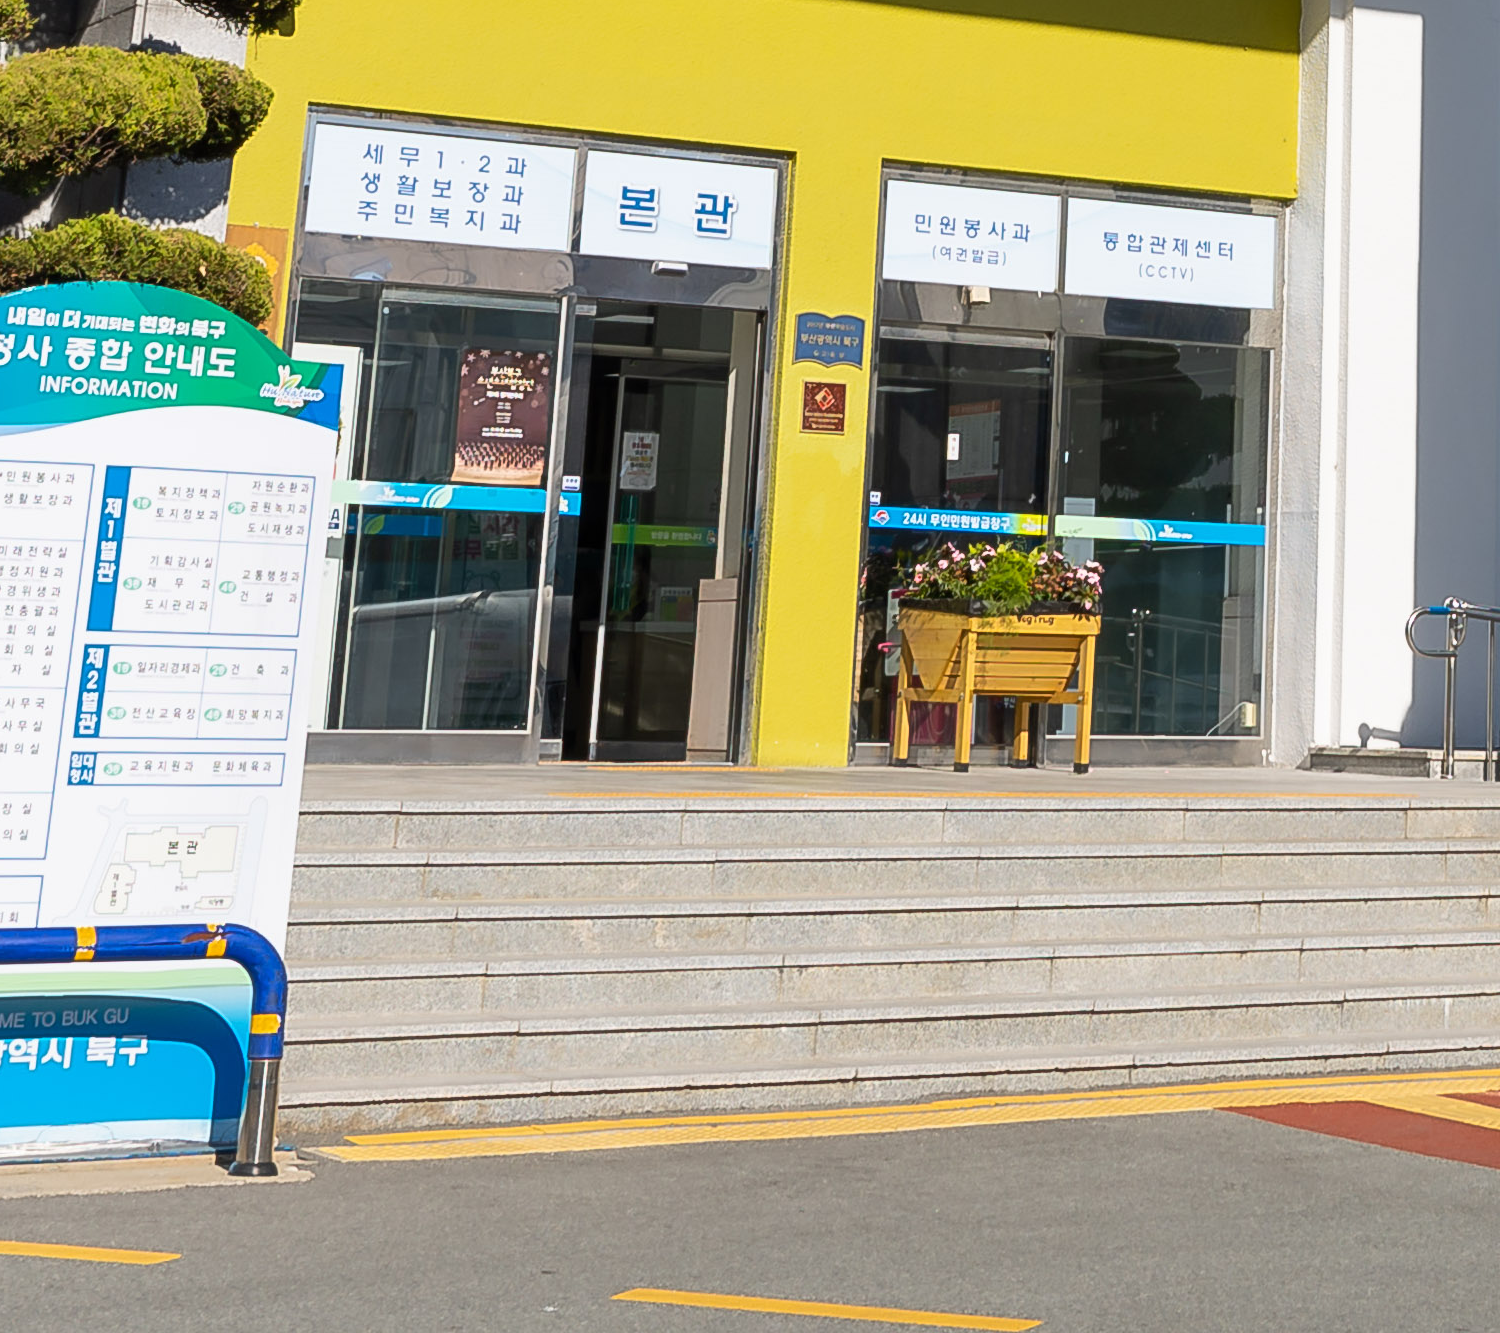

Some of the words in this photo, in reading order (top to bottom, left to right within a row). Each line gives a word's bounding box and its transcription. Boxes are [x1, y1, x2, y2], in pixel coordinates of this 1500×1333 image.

[1138, 263, 1194, 282] (CCTV)
[7, 306, 59, 327] 내일이
[62, 309, 81, 328] 더
[139, 314, 190, 336] 변화의
[64, 336, 132, 372] 종합
[144, 341, 237, 379] 안내도
[39, 374, 178, 400] INFORMATION
[902, 512, 927, 526] 24시
[31, 1011, 57, 1030] TO
[62, 1008, 98, 1027] BUK
[103, 1007, 130, 1025] GU
[87, 1035, 148, 1067] 북구
